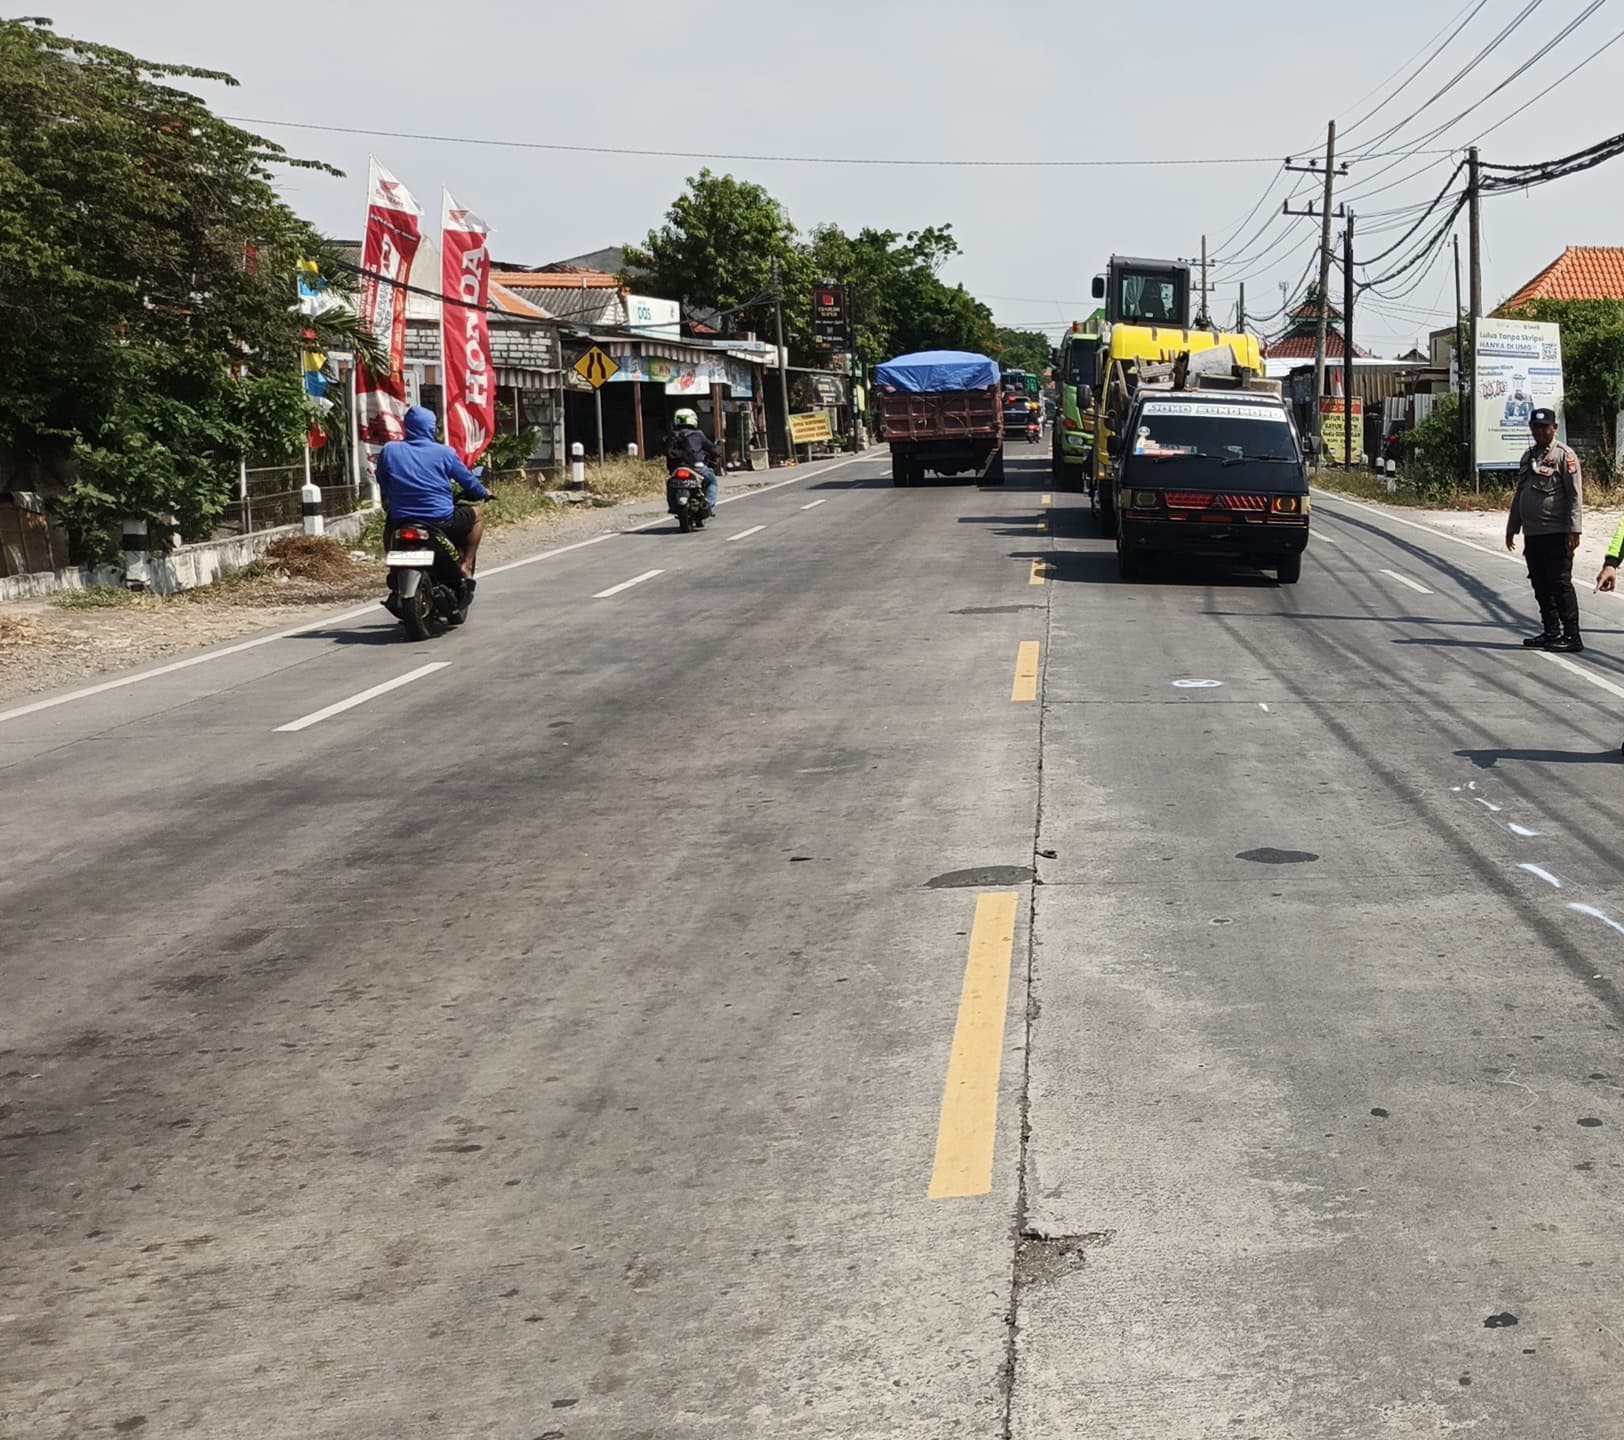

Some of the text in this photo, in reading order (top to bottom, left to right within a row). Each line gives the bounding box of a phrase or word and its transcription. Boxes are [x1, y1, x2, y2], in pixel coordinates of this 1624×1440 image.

[461, 246, 489, 408] HONDA
[1480, 331, 1544, 344] Lulus Tanpa Skripsi
[1480, 341, 1505, 349] HANYA
